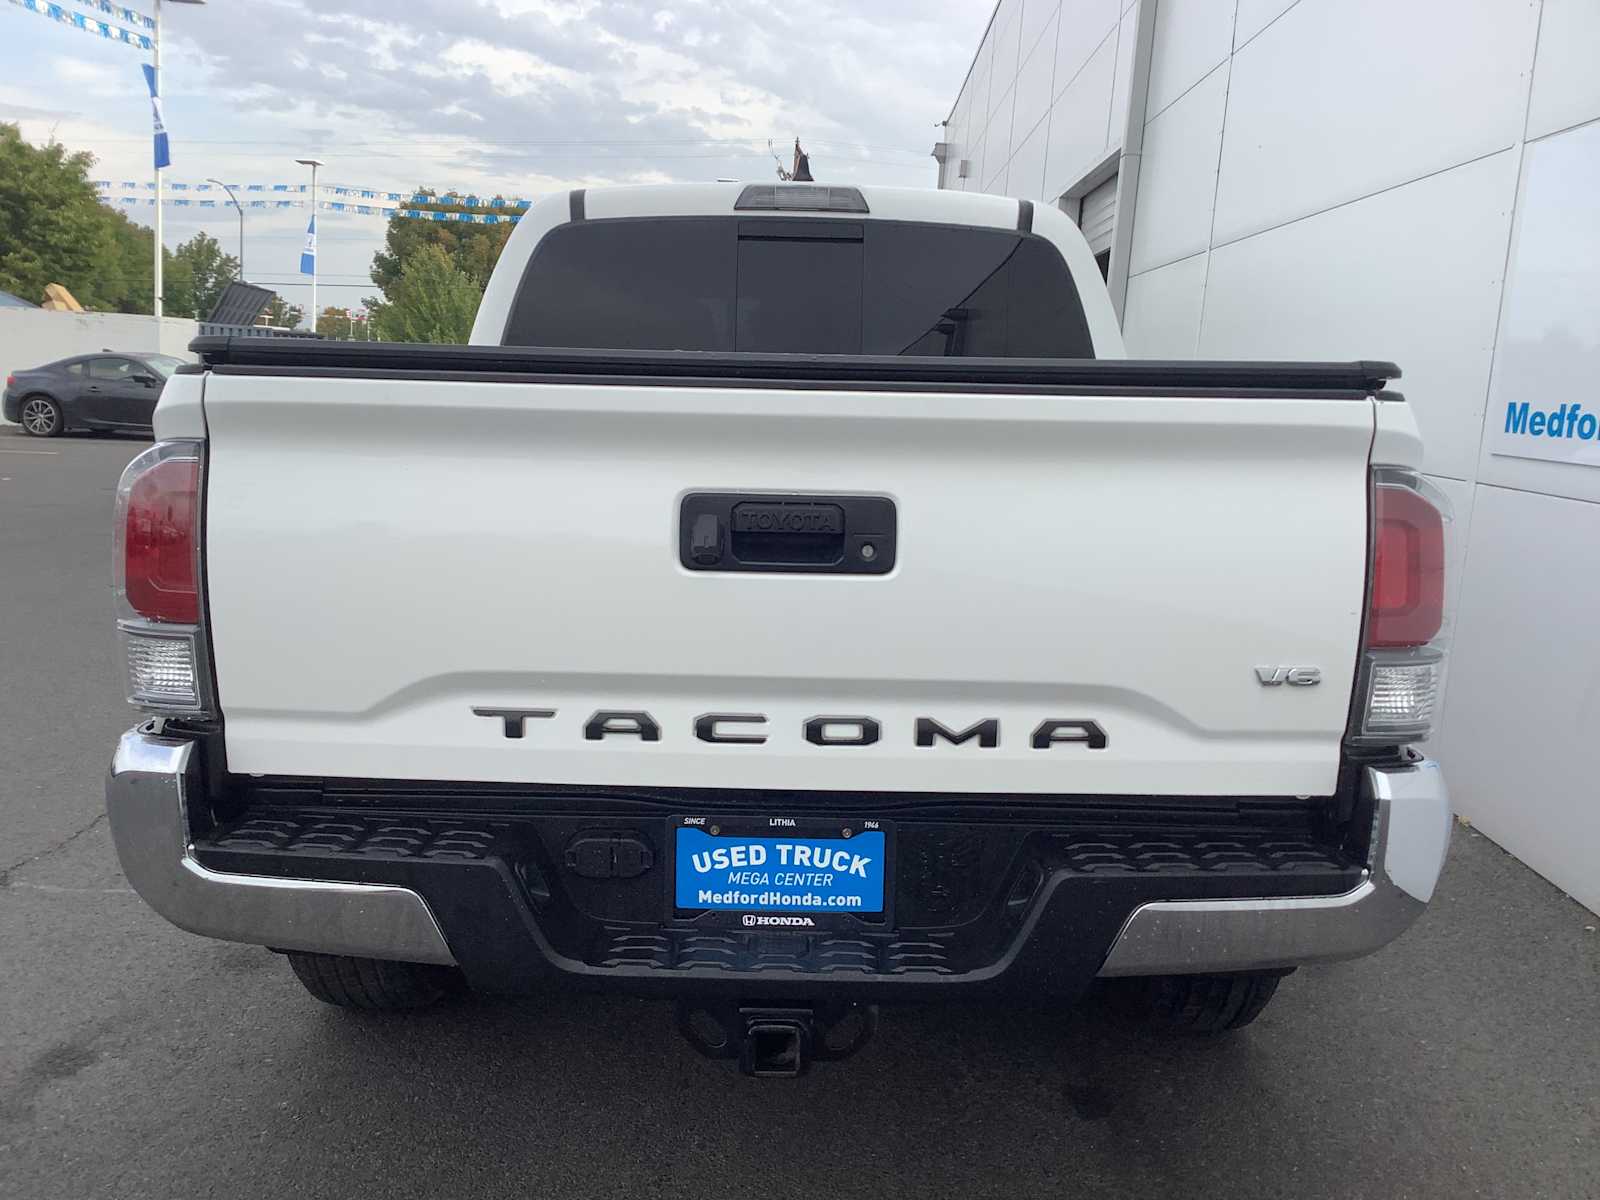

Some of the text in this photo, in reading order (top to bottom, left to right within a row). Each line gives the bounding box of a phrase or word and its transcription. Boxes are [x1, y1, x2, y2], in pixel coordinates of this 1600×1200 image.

[1504, 402, 1600, 440] Medfo
[741, 512, 836, 531] TOYOTA
[1254, 665, 1321, 687] V6
[471, 706, 1109, 749] TACOMA
[684, 817, 706, 825] SINCE
[769, 818, 796, 827] LITHIA
[691, 844, 872, 878] USED TRUCK
[727, 872, 833, 887] MEGA CENTER
[698, 890, 862, 907] MedfordHonda.com
[757, 916, 815, 926] HONDA
